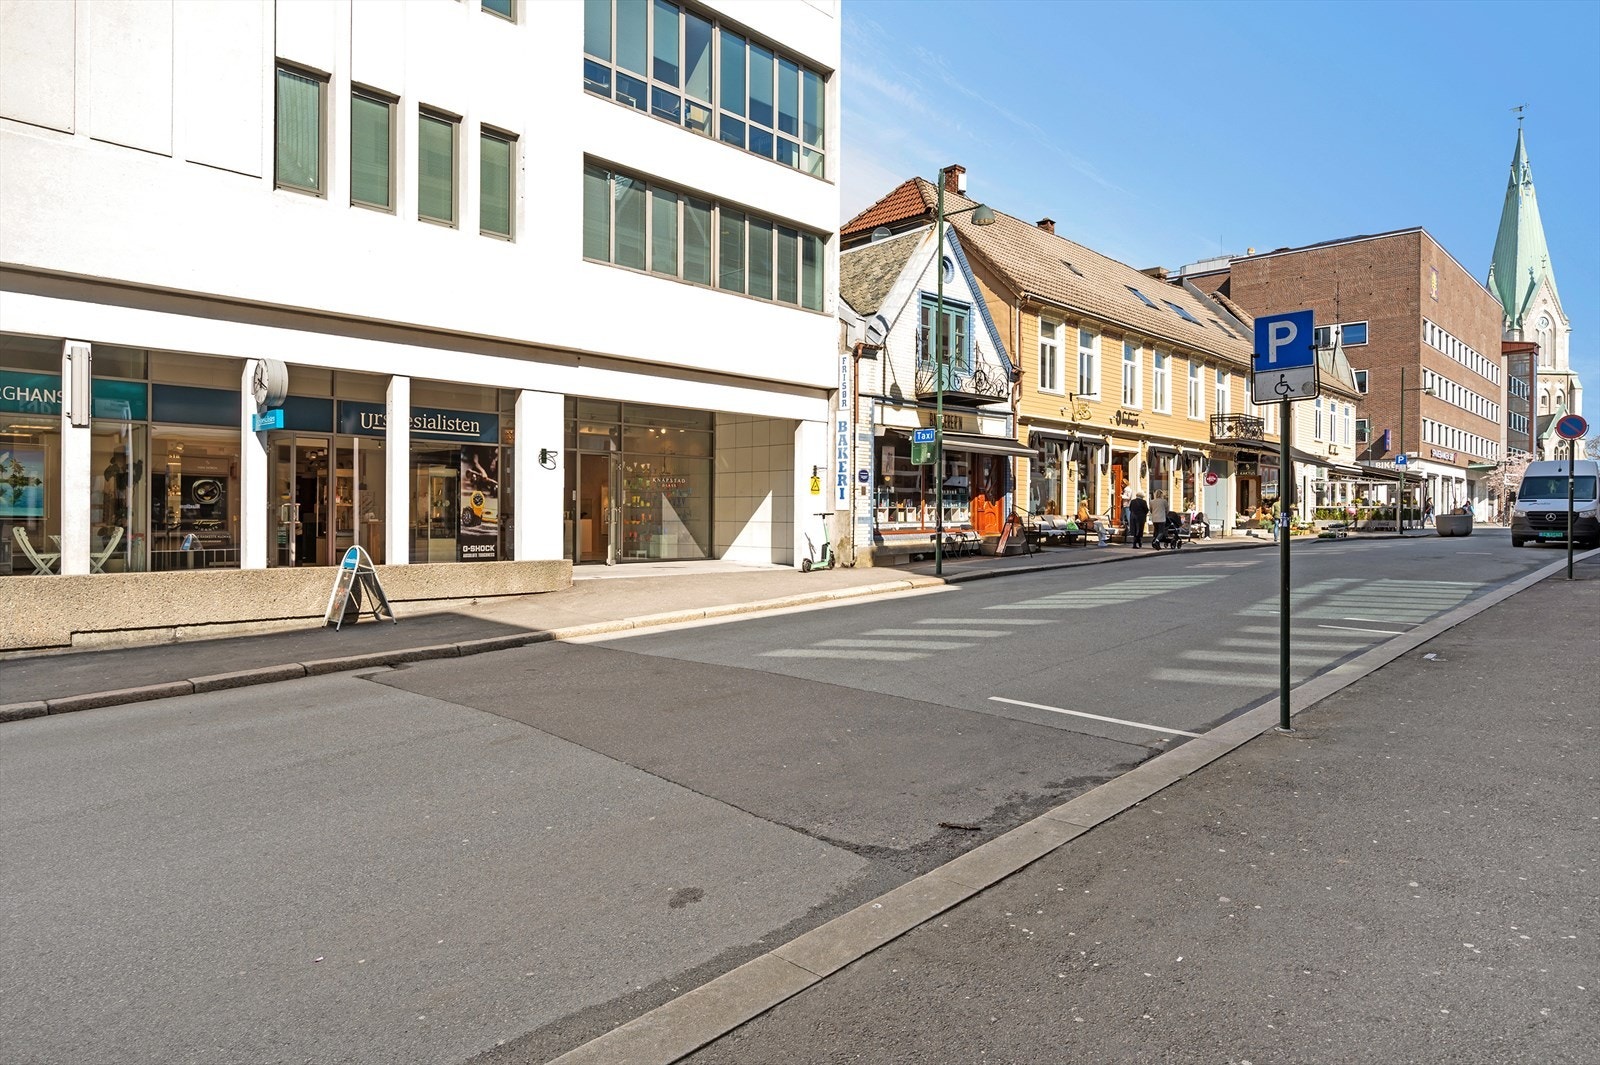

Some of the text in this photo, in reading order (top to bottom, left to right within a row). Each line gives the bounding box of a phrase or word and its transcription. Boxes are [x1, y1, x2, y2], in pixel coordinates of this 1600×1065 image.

[1268, 320, 1298, 364] P
[0, 385, 62, 404] GHANS
[916, 430, 933, 440] Taxi
[837, 420, 848, 500] BAKERI
[1397, 455, 1404, 464] P
[462, 544, 496, 553] G-SHOCK
